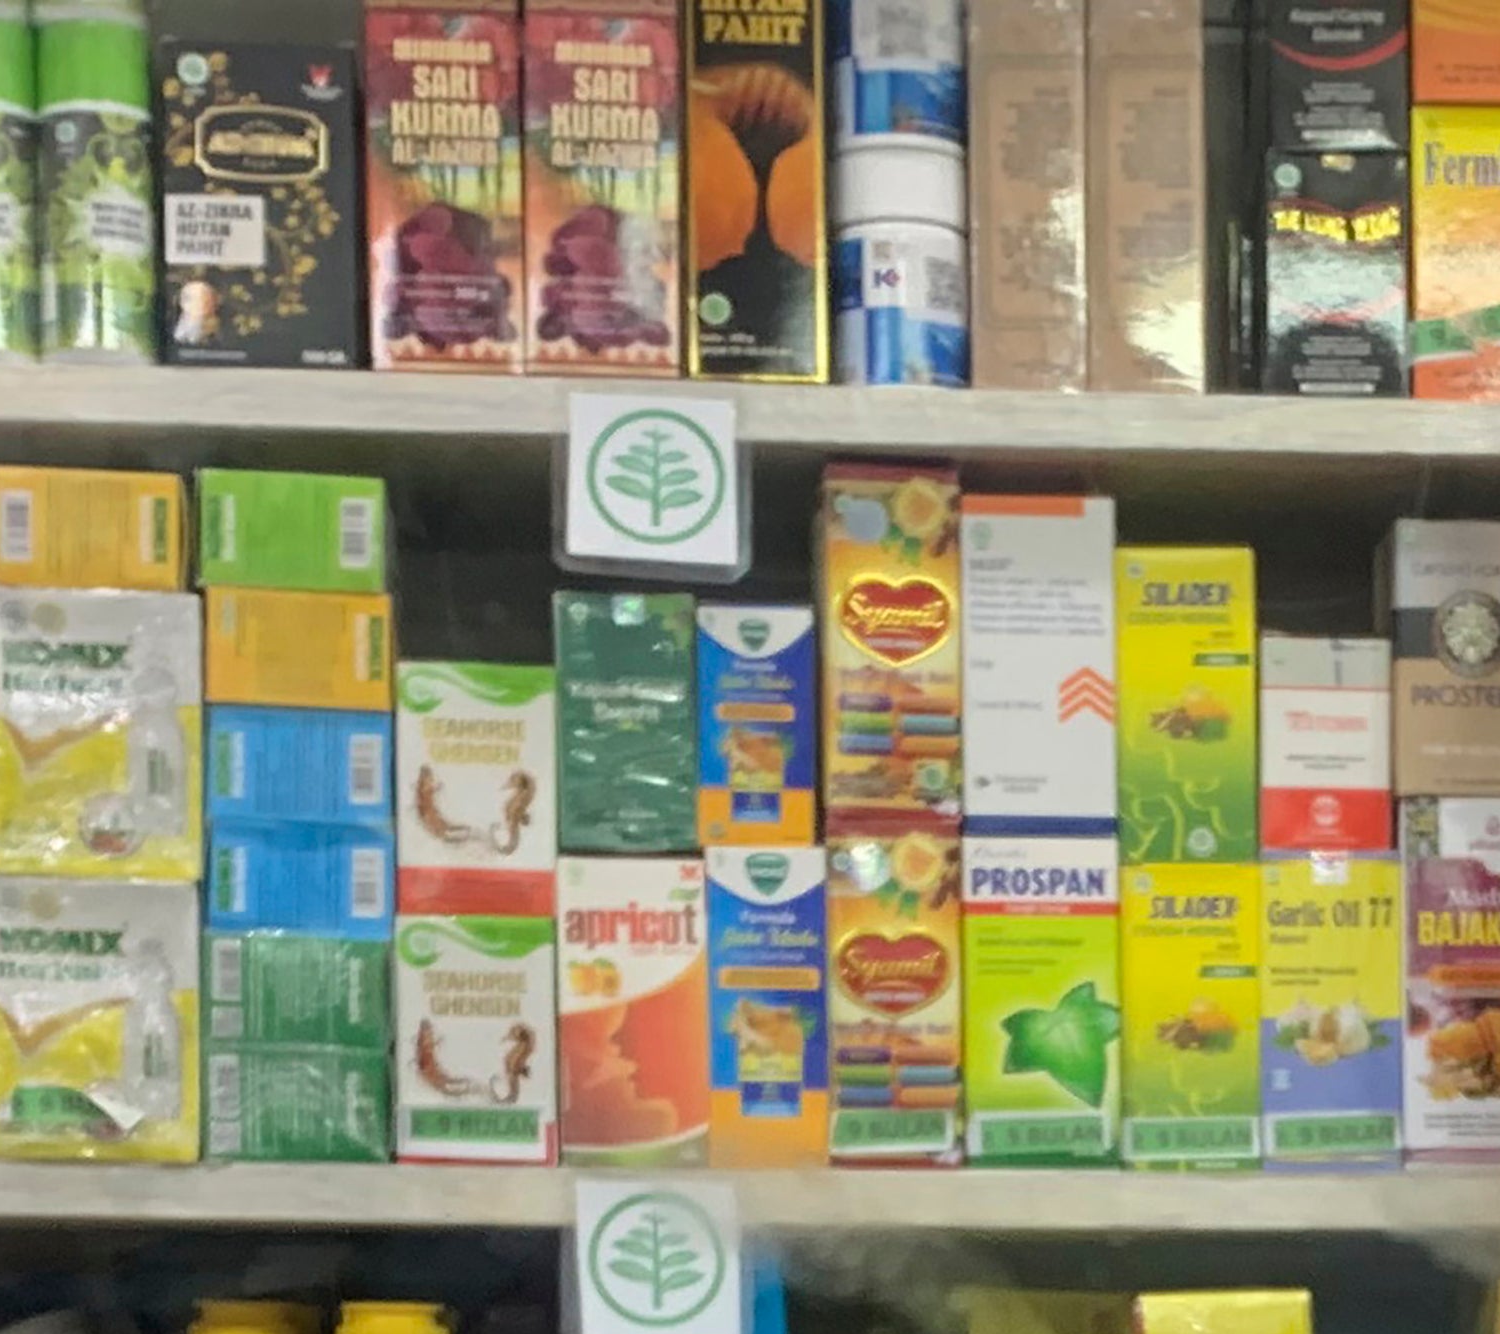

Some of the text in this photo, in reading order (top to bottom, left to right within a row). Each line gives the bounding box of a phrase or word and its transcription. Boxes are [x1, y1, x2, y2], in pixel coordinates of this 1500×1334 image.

[702, 15, 805, 44] PAHIT
[413, 65, 479, 98] SARI
[573, 66, 639, 101] SARI
[390, 103, 499, 138] KURMA
[551, 103, 659, 139] KURMA
[971, 868, 1105, 896] PROSPAN
[565, 904, 698, 951] apricot
[1267, 901, 1326, 928] Garlic
[1367, 898, 1393, 927] 77
